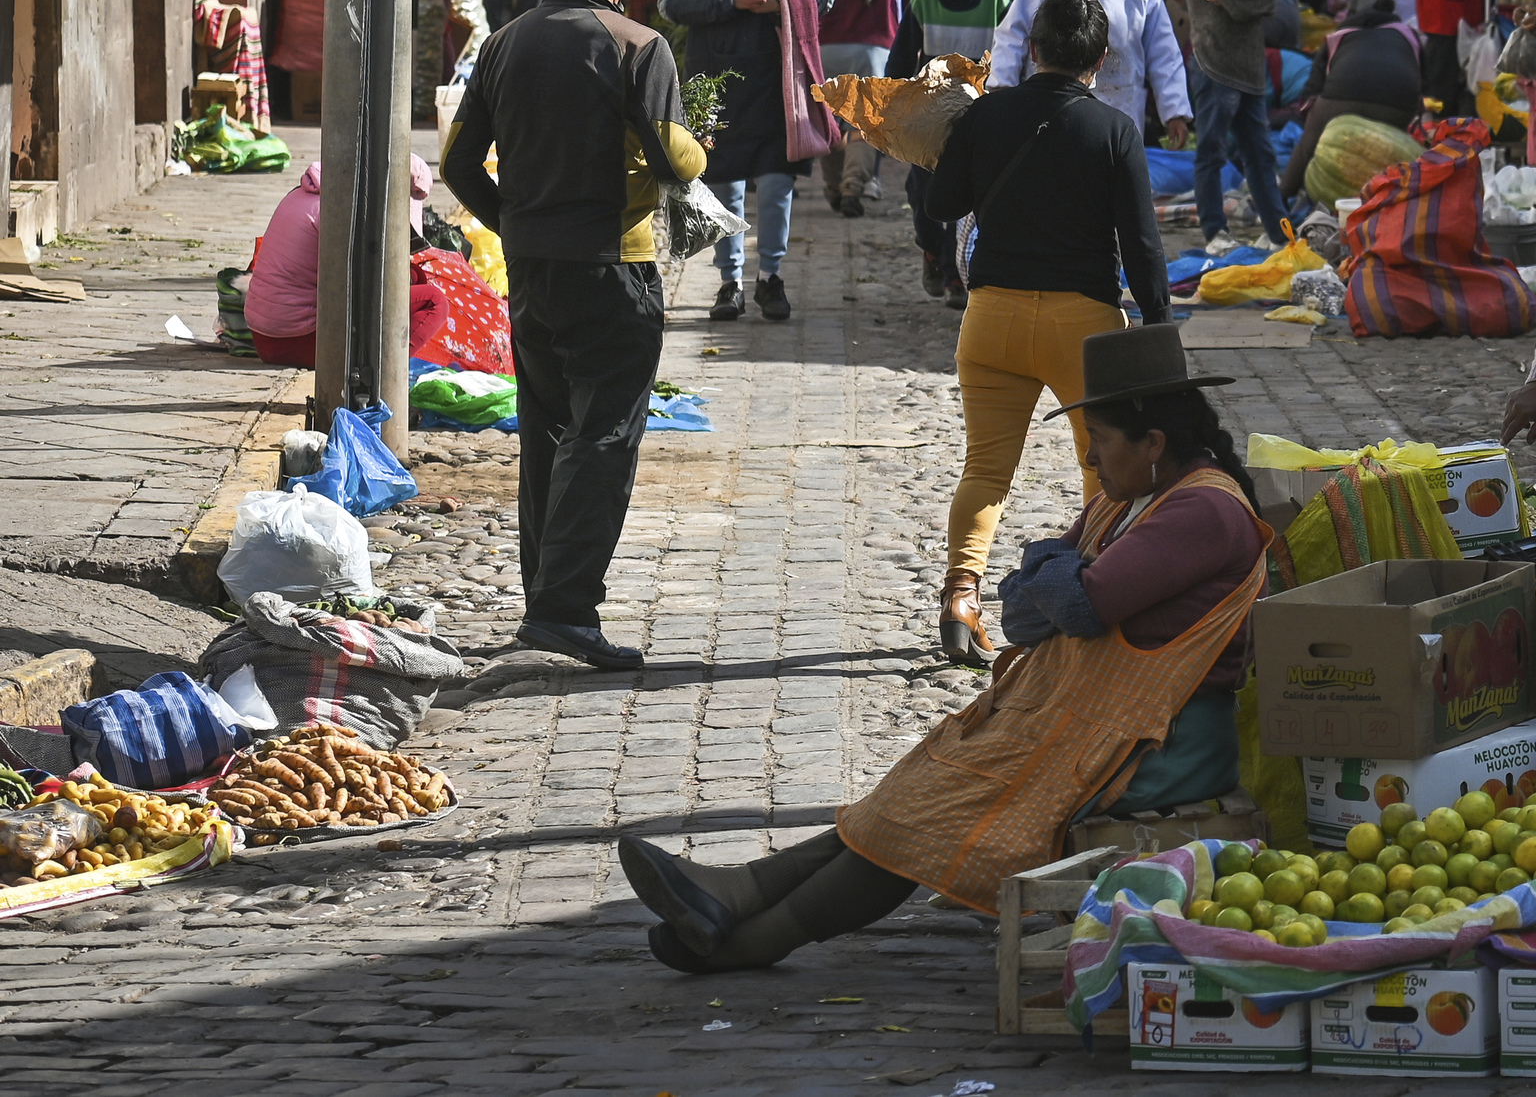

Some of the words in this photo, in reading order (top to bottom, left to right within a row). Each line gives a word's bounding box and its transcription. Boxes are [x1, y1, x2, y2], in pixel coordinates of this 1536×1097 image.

[1283, 691, 1314, 700] Calidad
[1317, 692, 1327, 700] de
[1329, 692, 1382, 702] Exportación
[1486, 755, 1530, 773] HUAYCO
[1372, 986, 1417, 995] HUAYCO
